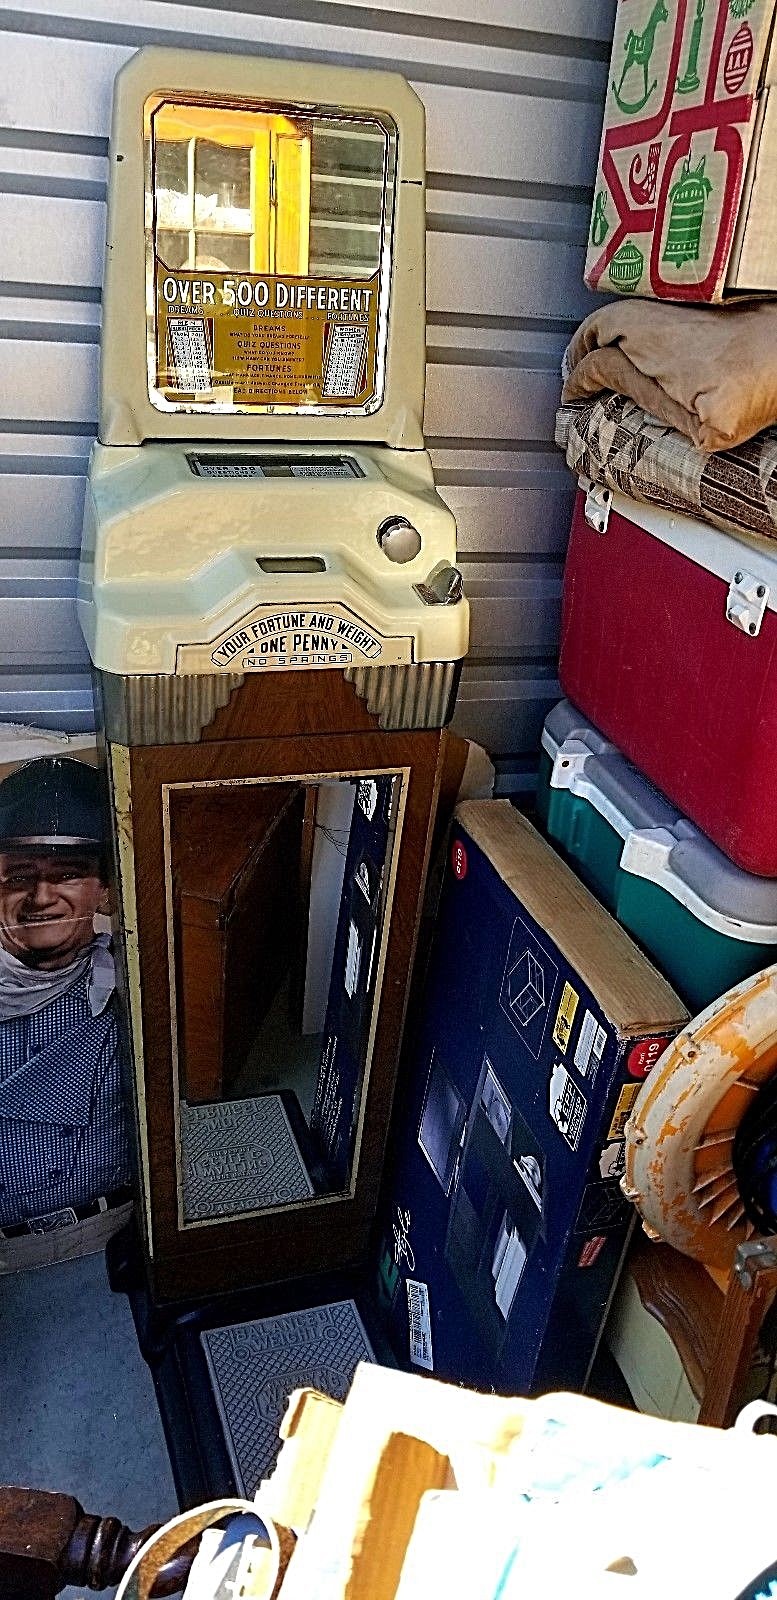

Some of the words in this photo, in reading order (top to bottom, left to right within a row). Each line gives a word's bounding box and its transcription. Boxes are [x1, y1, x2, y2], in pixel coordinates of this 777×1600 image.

[163, 277, 216, 305] OVER
[222, 279, 269, 307] 500
[276, 282, 373, 312] DIFFERENT
[168, 305, 204, 315] DREAMS
[233, 308, 255, 318] QUIZ
[257, 309, 304, 319] QUESTIONS
[327, 312, 369, 322] FORTUNES
[260, 341, 301, 349] QUESTIONS
[247, 364, 292, 373] FORTUNES
[217, 631, 251, 659] YOUR
[251, 614, 306, 639] FORTUNE
[309, 614, 335, 631] AND
[336, 620, 377, 652] WEIGHT
[261, 635, 288, 654] ONE
[293, 633, 338, 652] PENNY
[247, 657, 267, 666] NO
[278, 654, 348, 664] SPRINGS
[643, 1043, 660, 1072] 0119
[235, 1311, 329, 1341] BALANCED
[252, 1326, 319, 1348] WEIGHT
